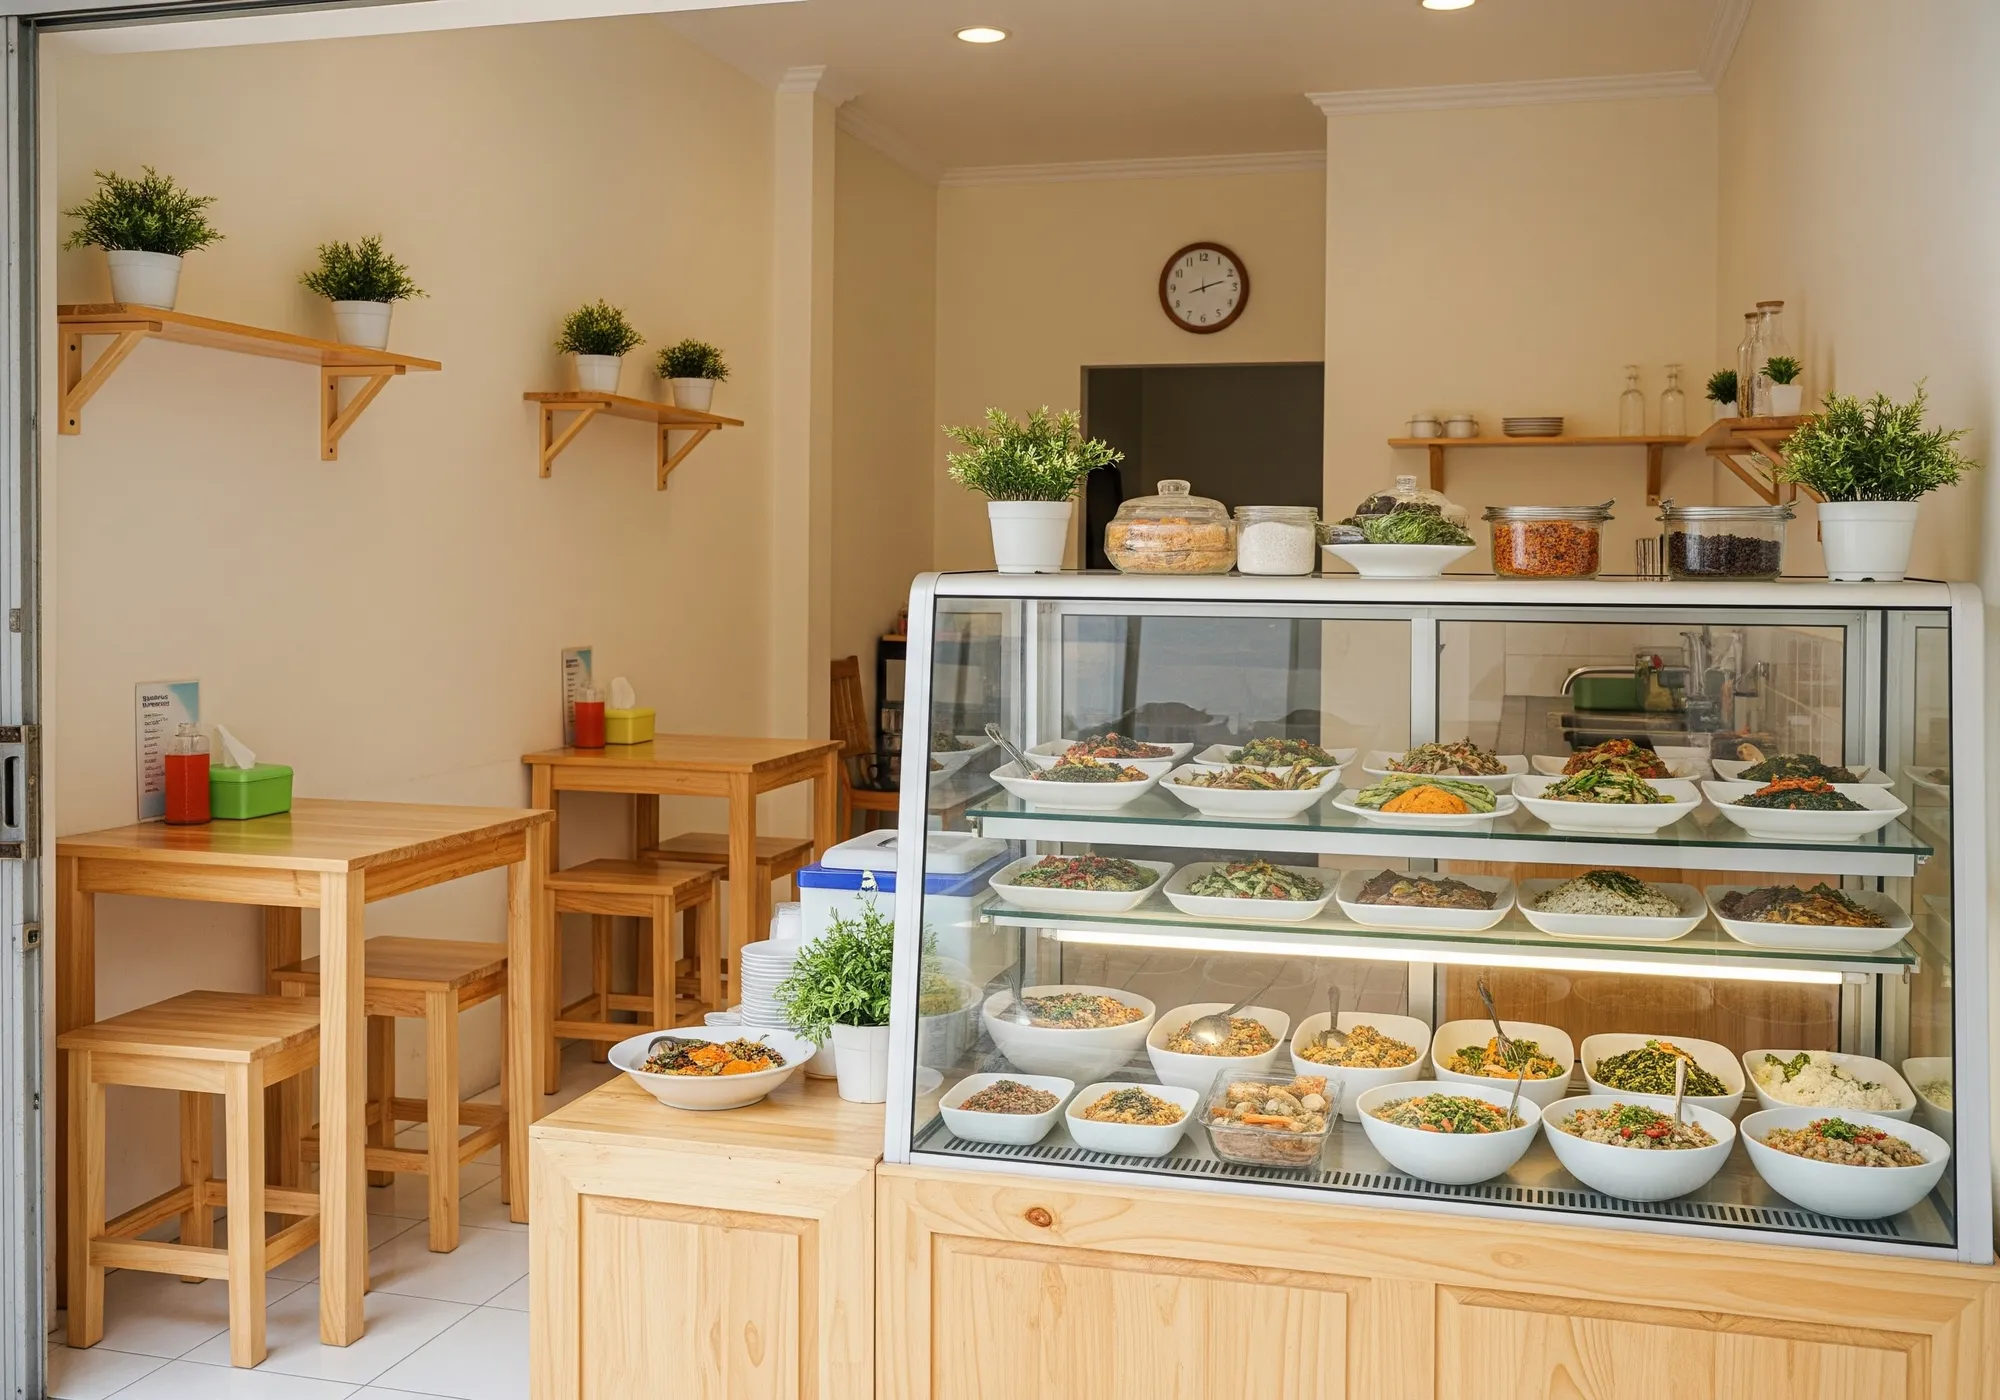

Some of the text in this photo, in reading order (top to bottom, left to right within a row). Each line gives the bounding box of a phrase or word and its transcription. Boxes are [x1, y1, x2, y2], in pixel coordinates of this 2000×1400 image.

[1199, 252, 1209, 261] 12
[1217, 256, 1221, 266] 1
[1186, 257, 1193, 267] 11
[1227, 269, 1234, 278] 2
[1170, 284, 1177, 293] 9
[1232, 282, 1238, 292] 3
[1175, 300, 1180, 308] 8
[1187, 310, 1193, 320] 7
[1216, 309, 1222, 318] 5
[1200, 314, 1206, 323] 6
